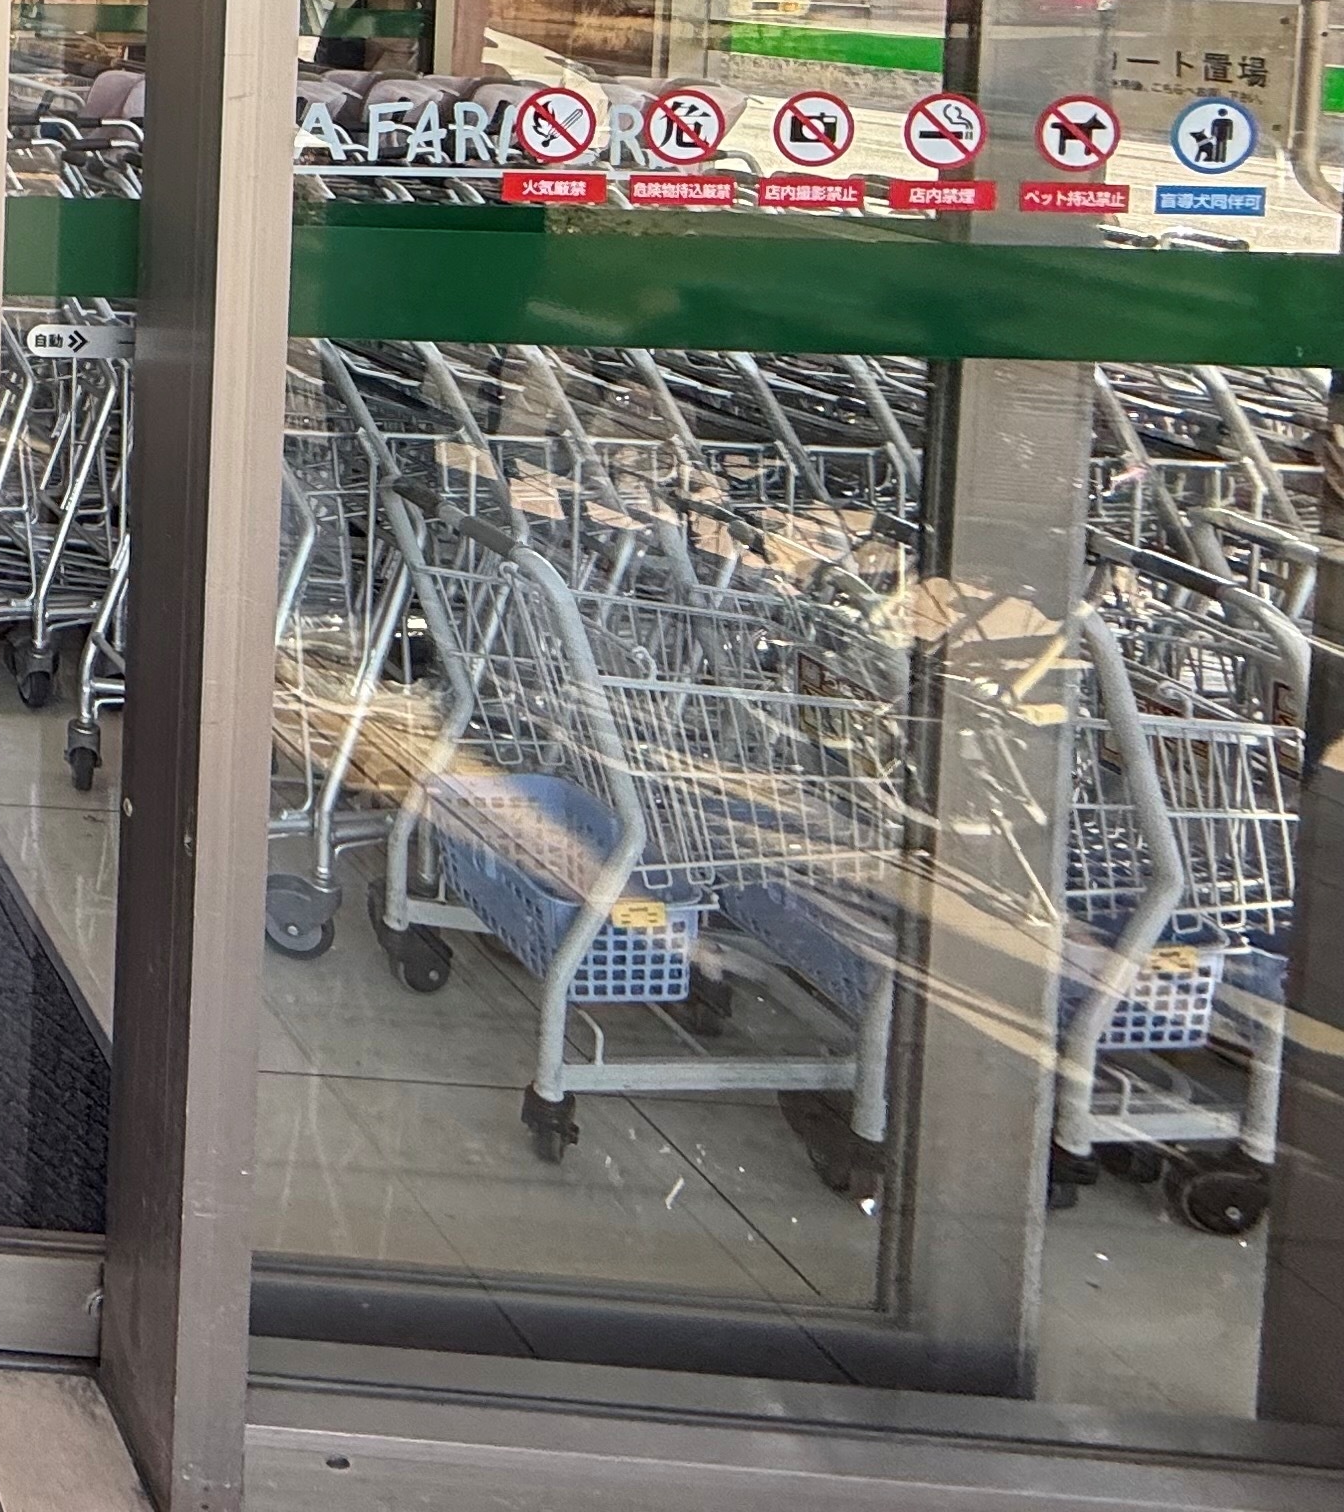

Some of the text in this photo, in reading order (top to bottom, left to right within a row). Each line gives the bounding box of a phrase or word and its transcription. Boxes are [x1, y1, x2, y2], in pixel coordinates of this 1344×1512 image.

[522, 179, 587, 196] 火気厳禁
[764, 185, 858, 204] 店内撮影禁止
[908, 188, 976, 205] 店内禁煙
[1024, 189, 1126, 209] ペット持込禁止
[1159, 193, 1263, 211] 盲導犬同伴可
[34, 333, 63, 348] 自動
